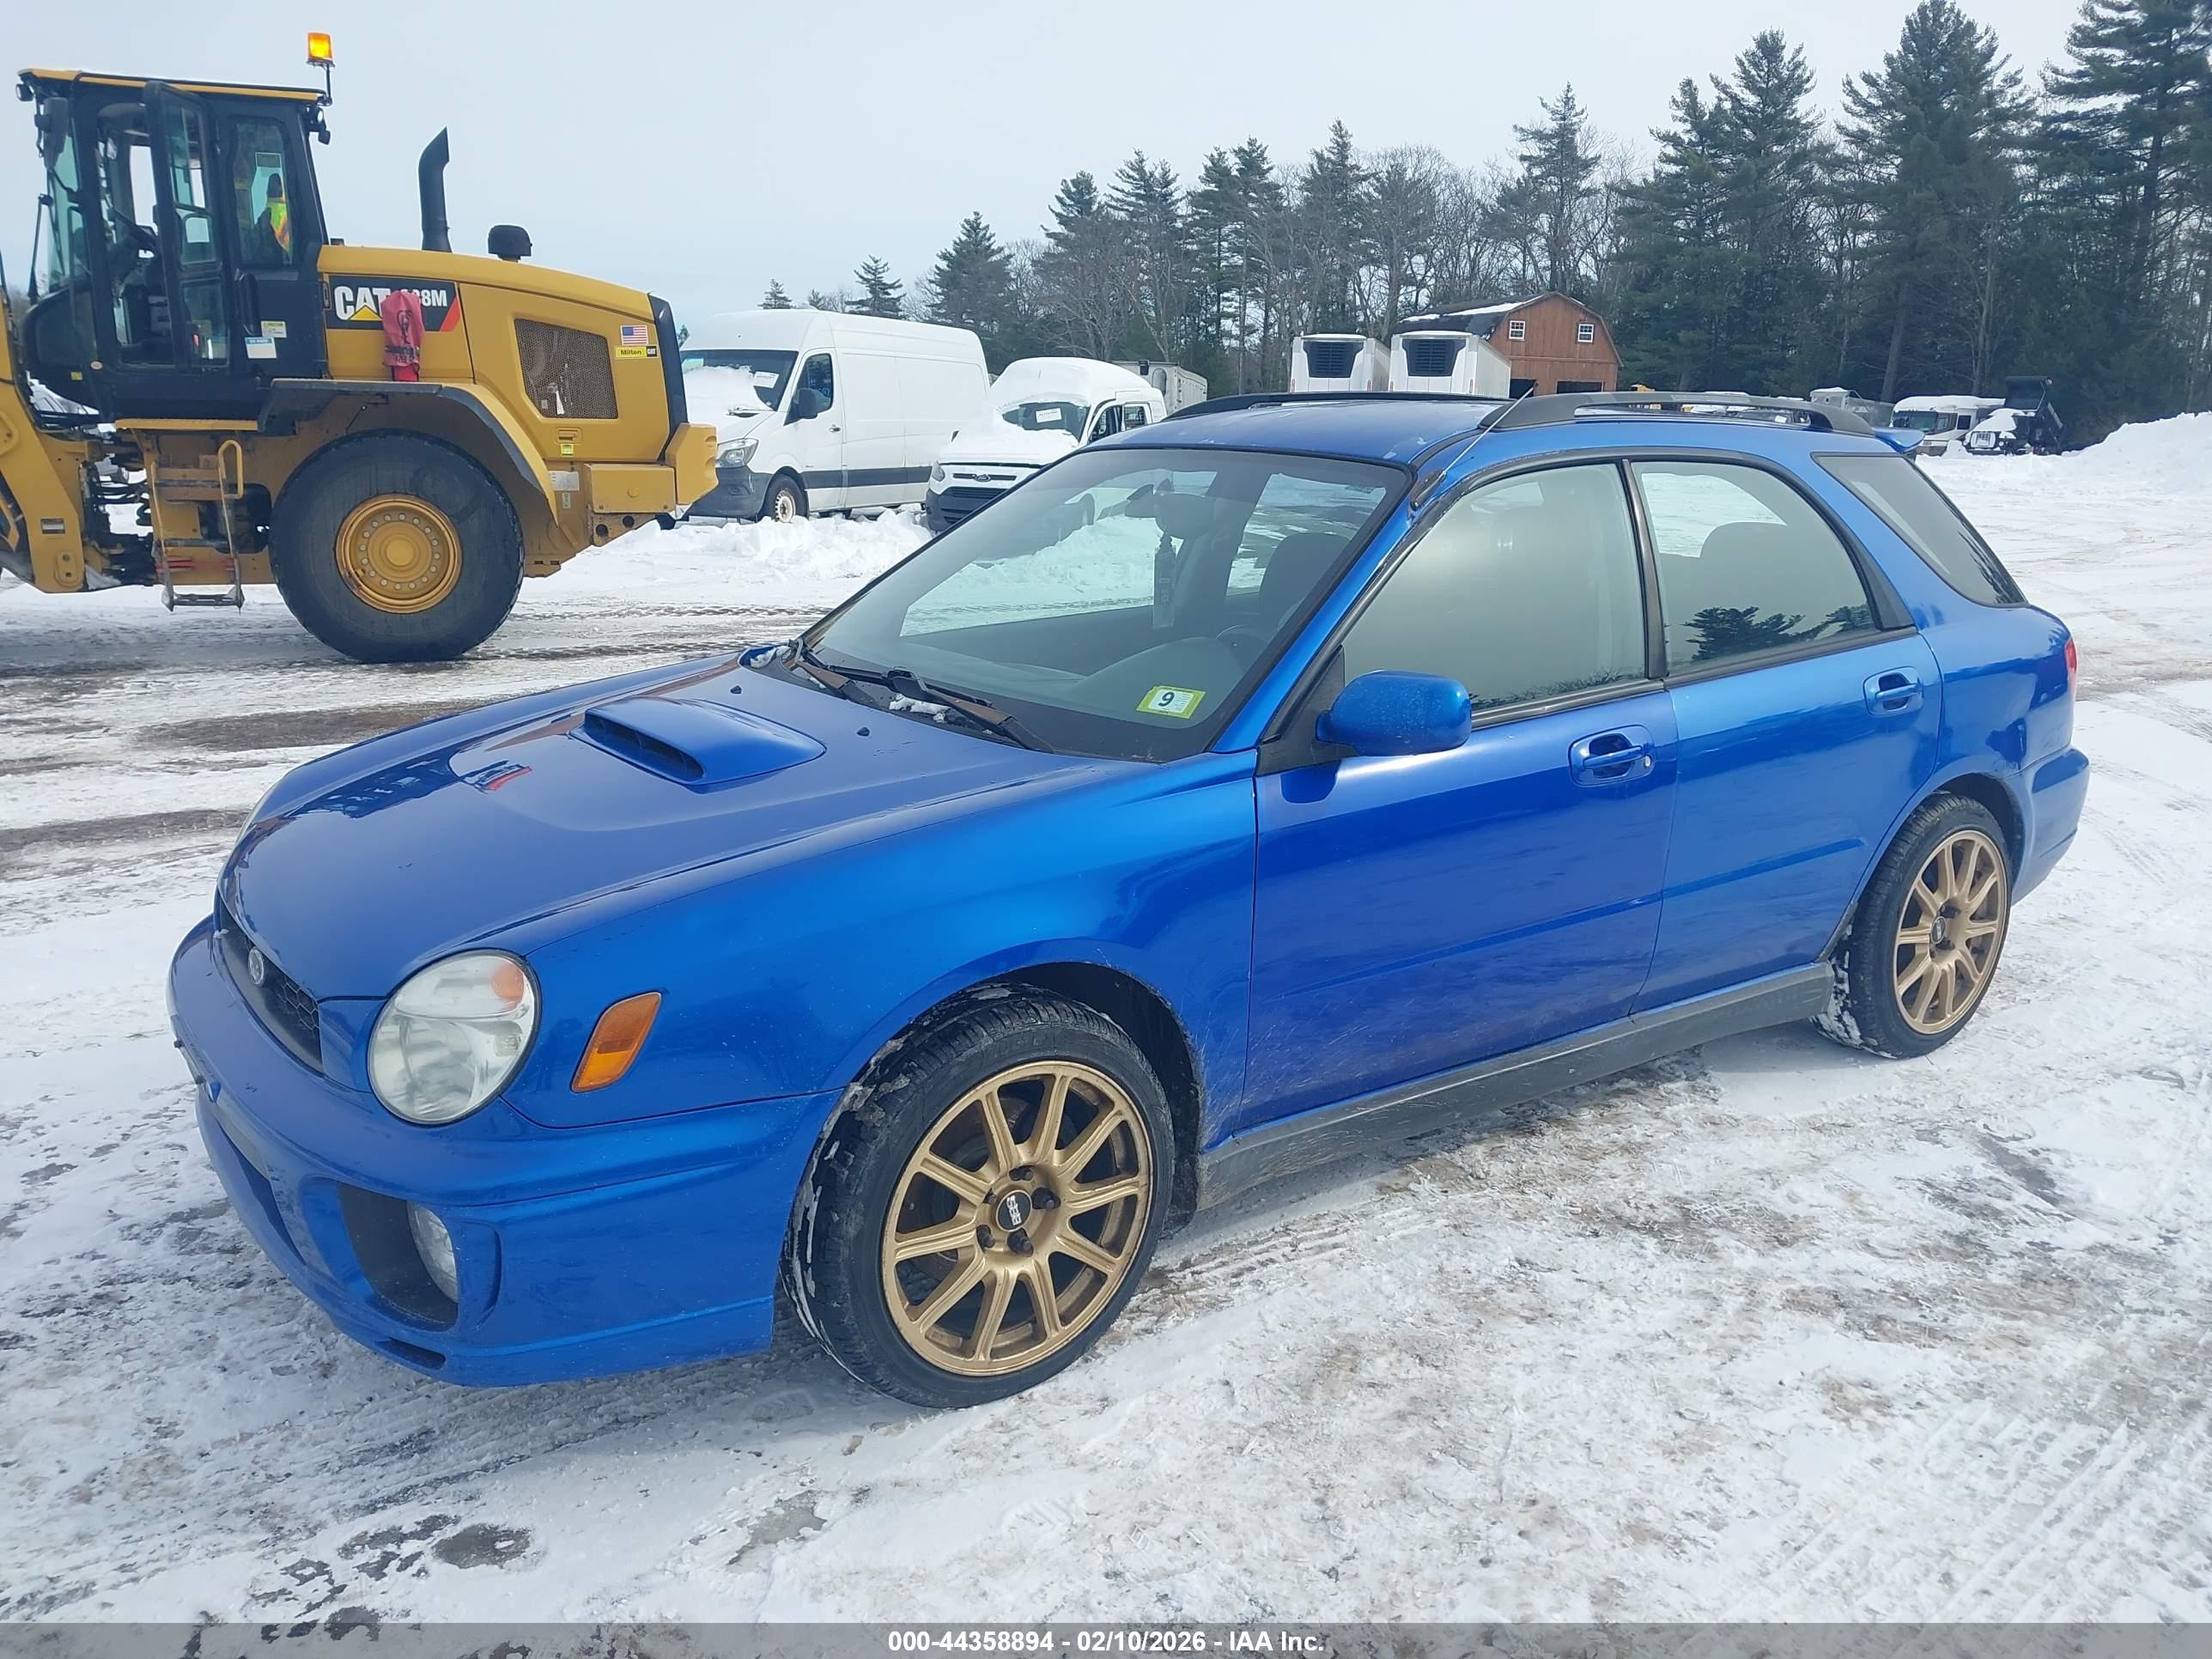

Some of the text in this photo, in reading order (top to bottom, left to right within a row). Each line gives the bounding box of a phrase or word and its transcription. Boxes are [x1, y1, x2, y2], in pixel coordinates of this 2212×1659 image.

[334, 286, 391, 321] CAT
[1157, 691, 1176, 708] 9
[1006, 1194, 1022, 1226] BBS
